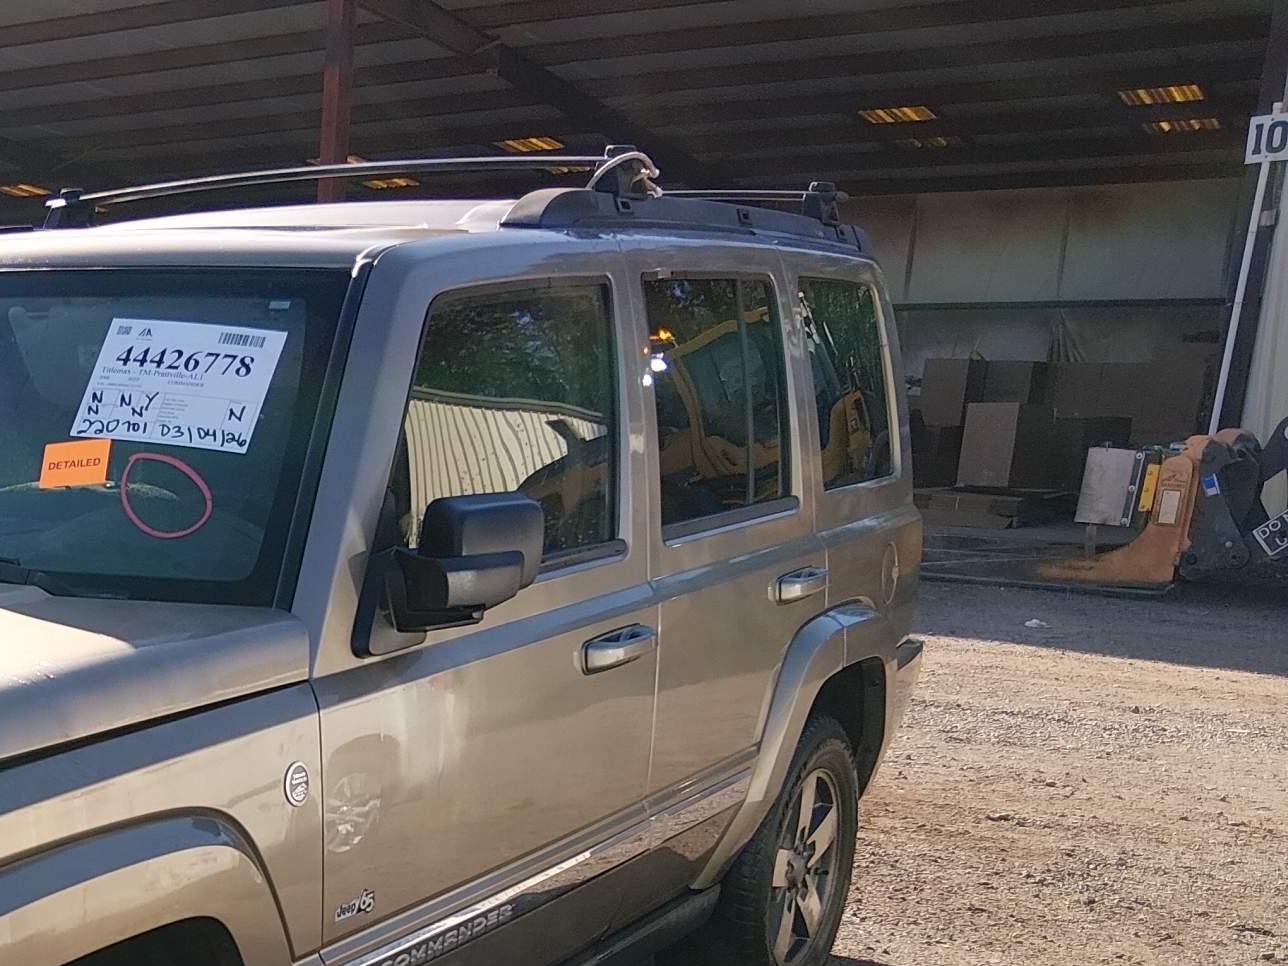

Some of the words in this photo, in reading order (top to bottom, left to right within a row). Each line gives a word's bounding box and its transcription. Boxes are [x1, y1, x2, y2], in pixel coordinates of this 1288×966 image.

[116, 346, 255, 377] 44426778
[92, 391, 104, 403] N
[119, 393, 132, 407] N
[144, 391, 160, 411] Y
[228, 406, 246, 422] N
[48, 457, 101, 471] DETAILED
[336, 901, 357, 919] Jeep
